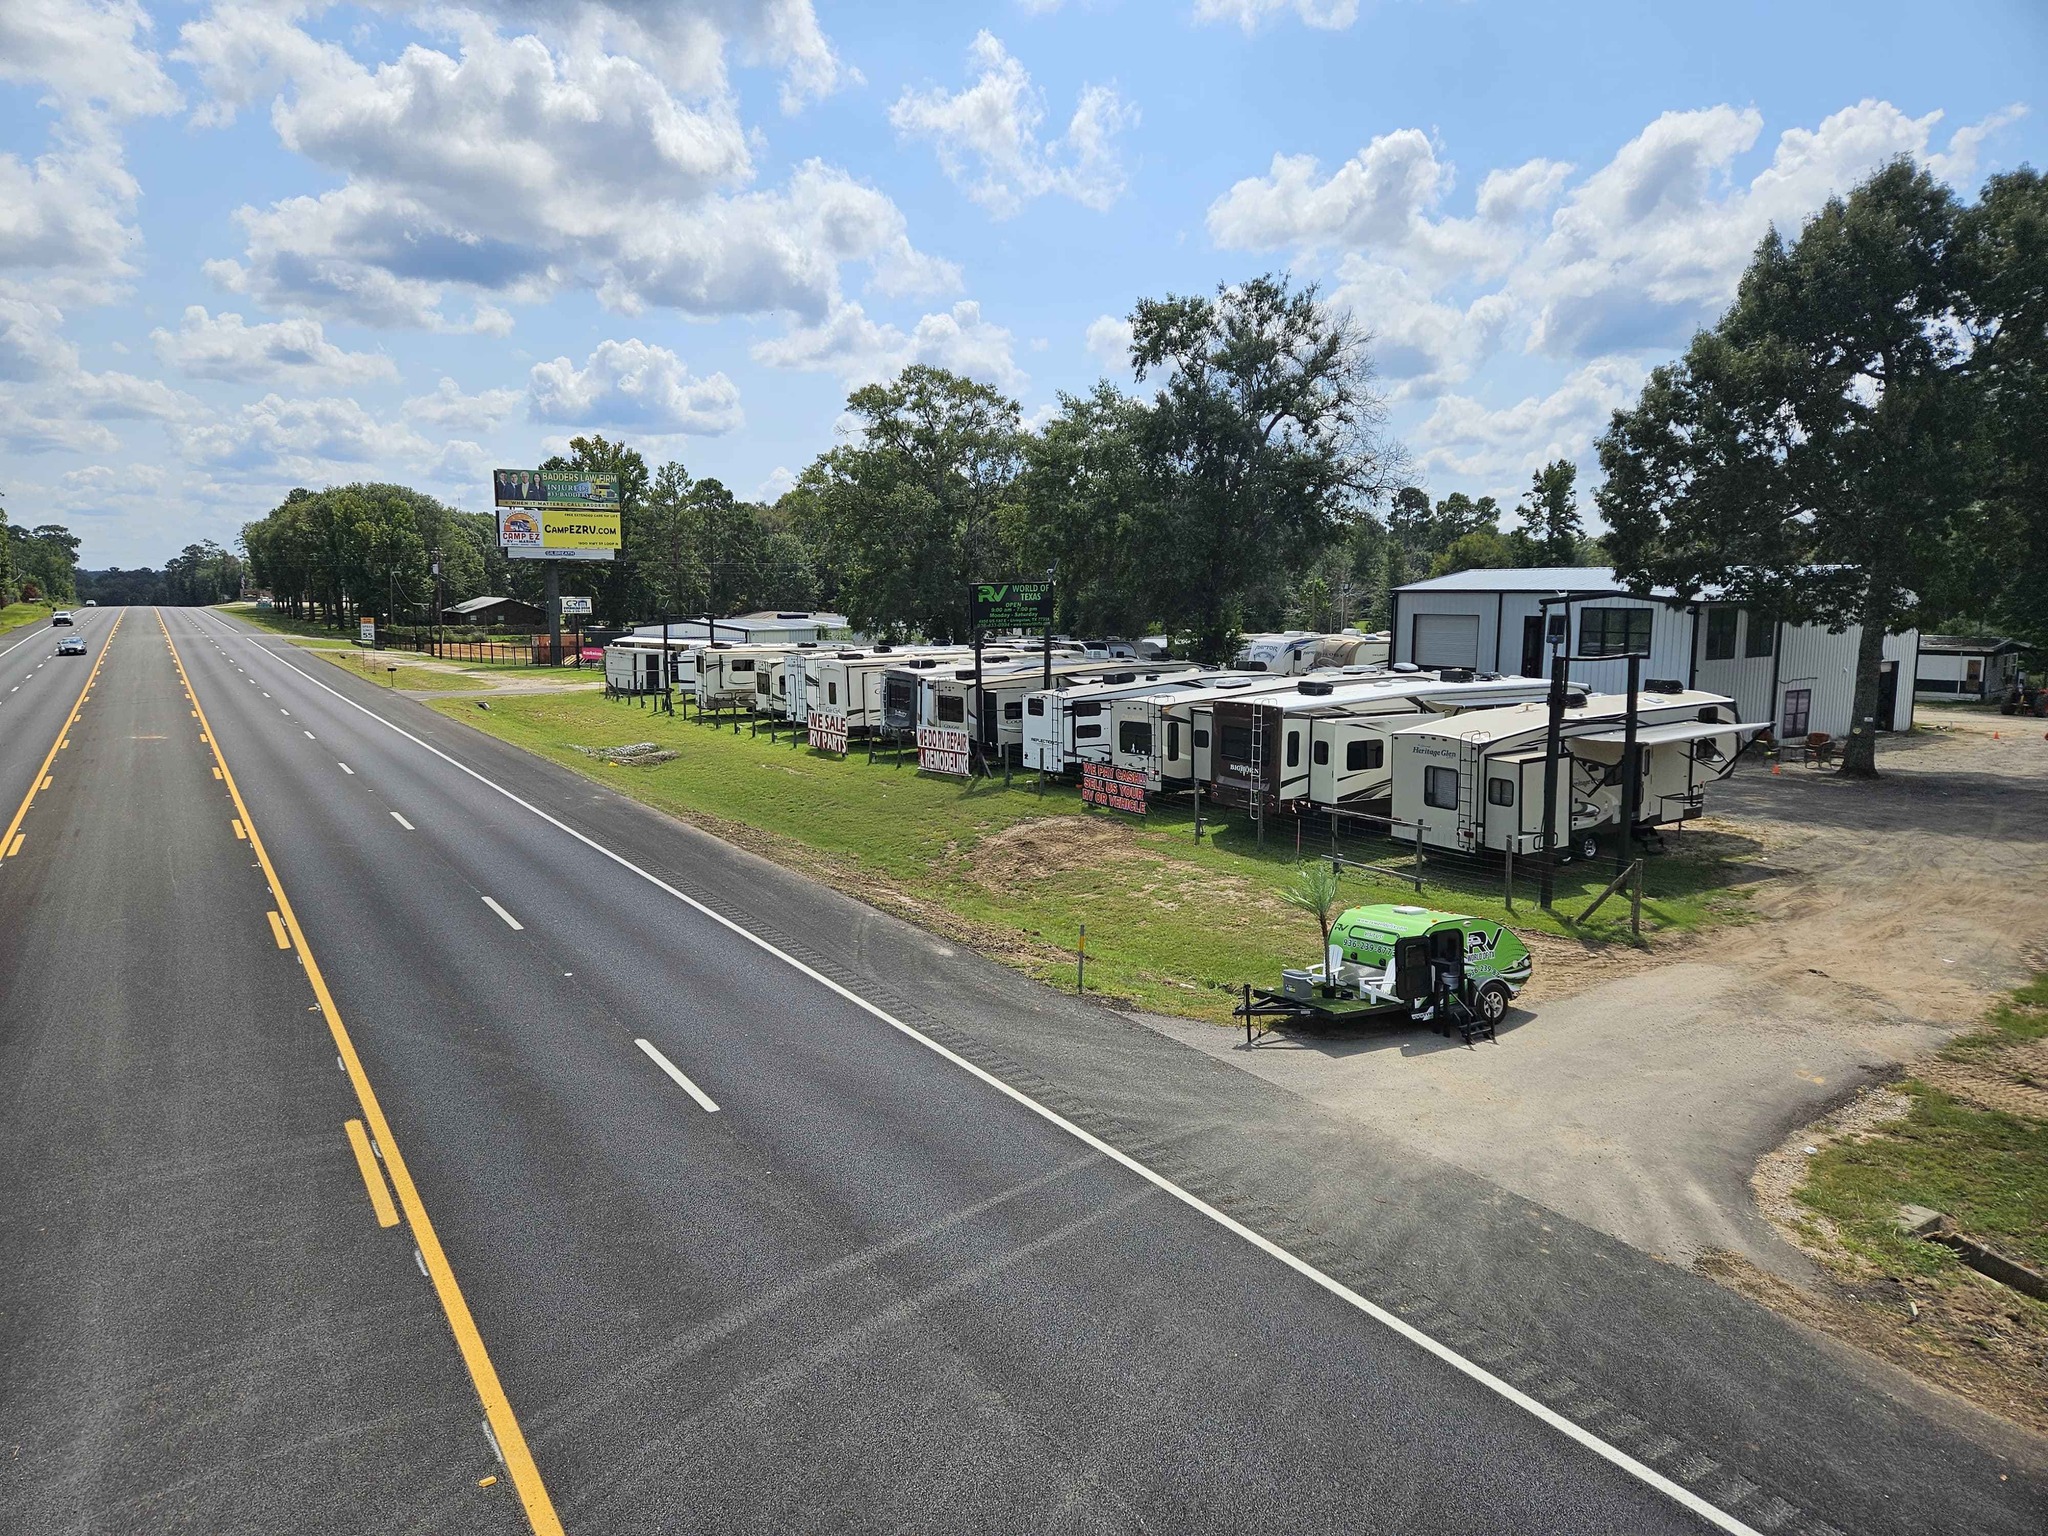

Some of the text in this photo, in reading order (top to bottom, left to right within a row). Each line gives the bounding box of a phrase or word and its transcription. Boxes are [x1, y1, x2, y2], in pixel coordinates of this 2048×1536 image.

[542, 472, 617, 483] BADDERS LAW FIRM
[978, 585, 1009, 602] RV
[809, 712, 846, 733] WE SALE
[810, 730, 847, 753] RV PARTS
[918, 728, 927, 746] WE
[928, 729, 936, 747] DO
[947, 731, 967, 751] REPAIR
[926, 750, 968, 774] REMODELING
[1412, 747, 1440, 757] Heritage
[1083, 762, 1096, 775] WE
[1098, 765, 1114, 779] PAY
[1084, 777, 1144, 800] SELL US YOUR
[1082, 788, 1146, 814] RV OR VEHICLE
[1335, 923, 1349, 931] RV
[1468, 928, 1503, 954] RV
[1467, 953, 1482, 961] WORLD
